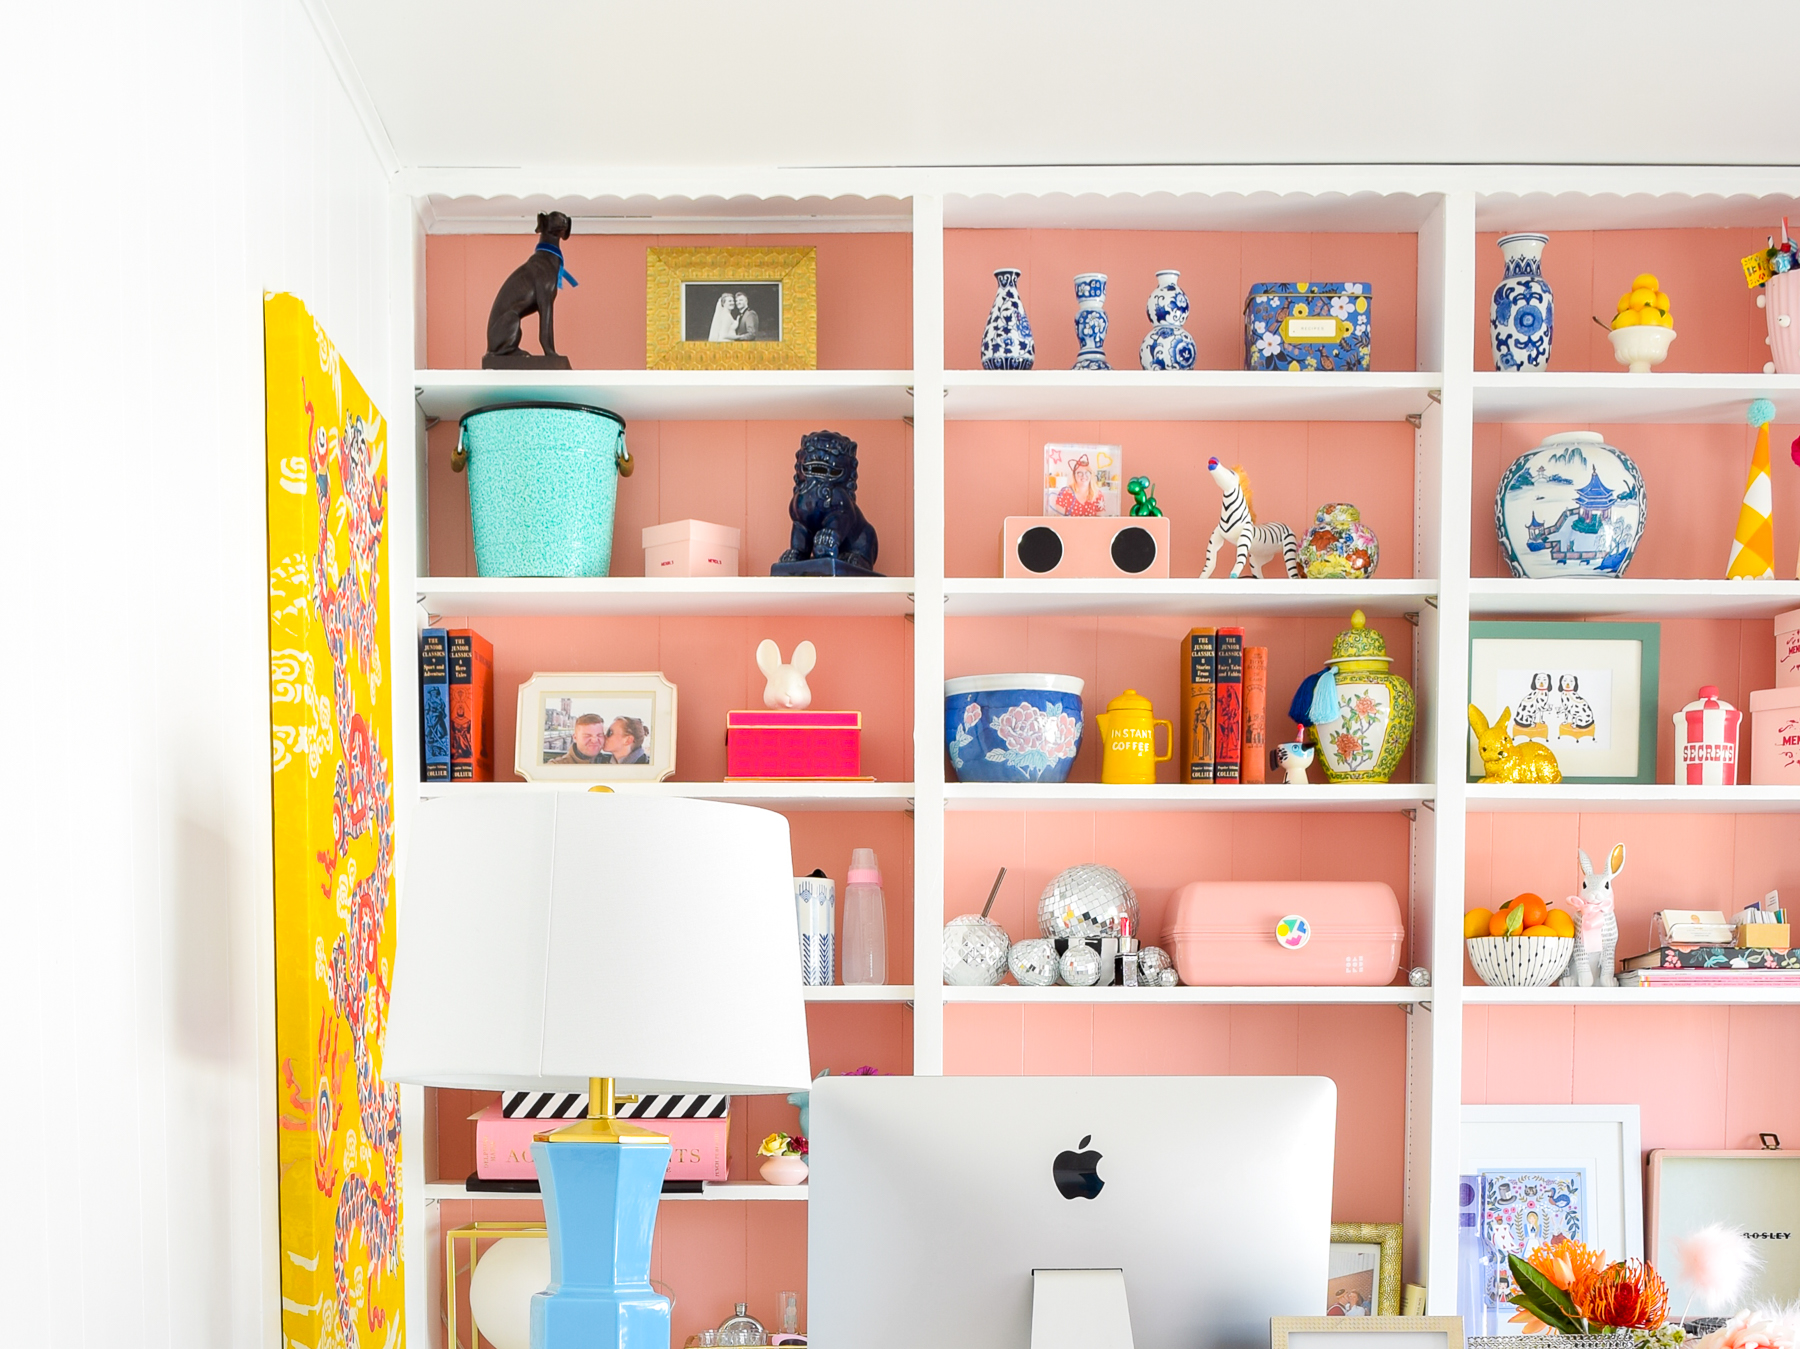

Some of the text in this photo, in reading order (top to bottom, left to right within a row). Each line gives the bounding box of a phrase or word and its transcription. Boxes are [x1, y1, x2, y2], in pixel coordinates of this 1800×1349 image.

[1111, 729, 1152, 739] INSTANT
[1112, 742, 1150, 752] COFFEE
[1683, 744, 1733, 762] SECRETS
